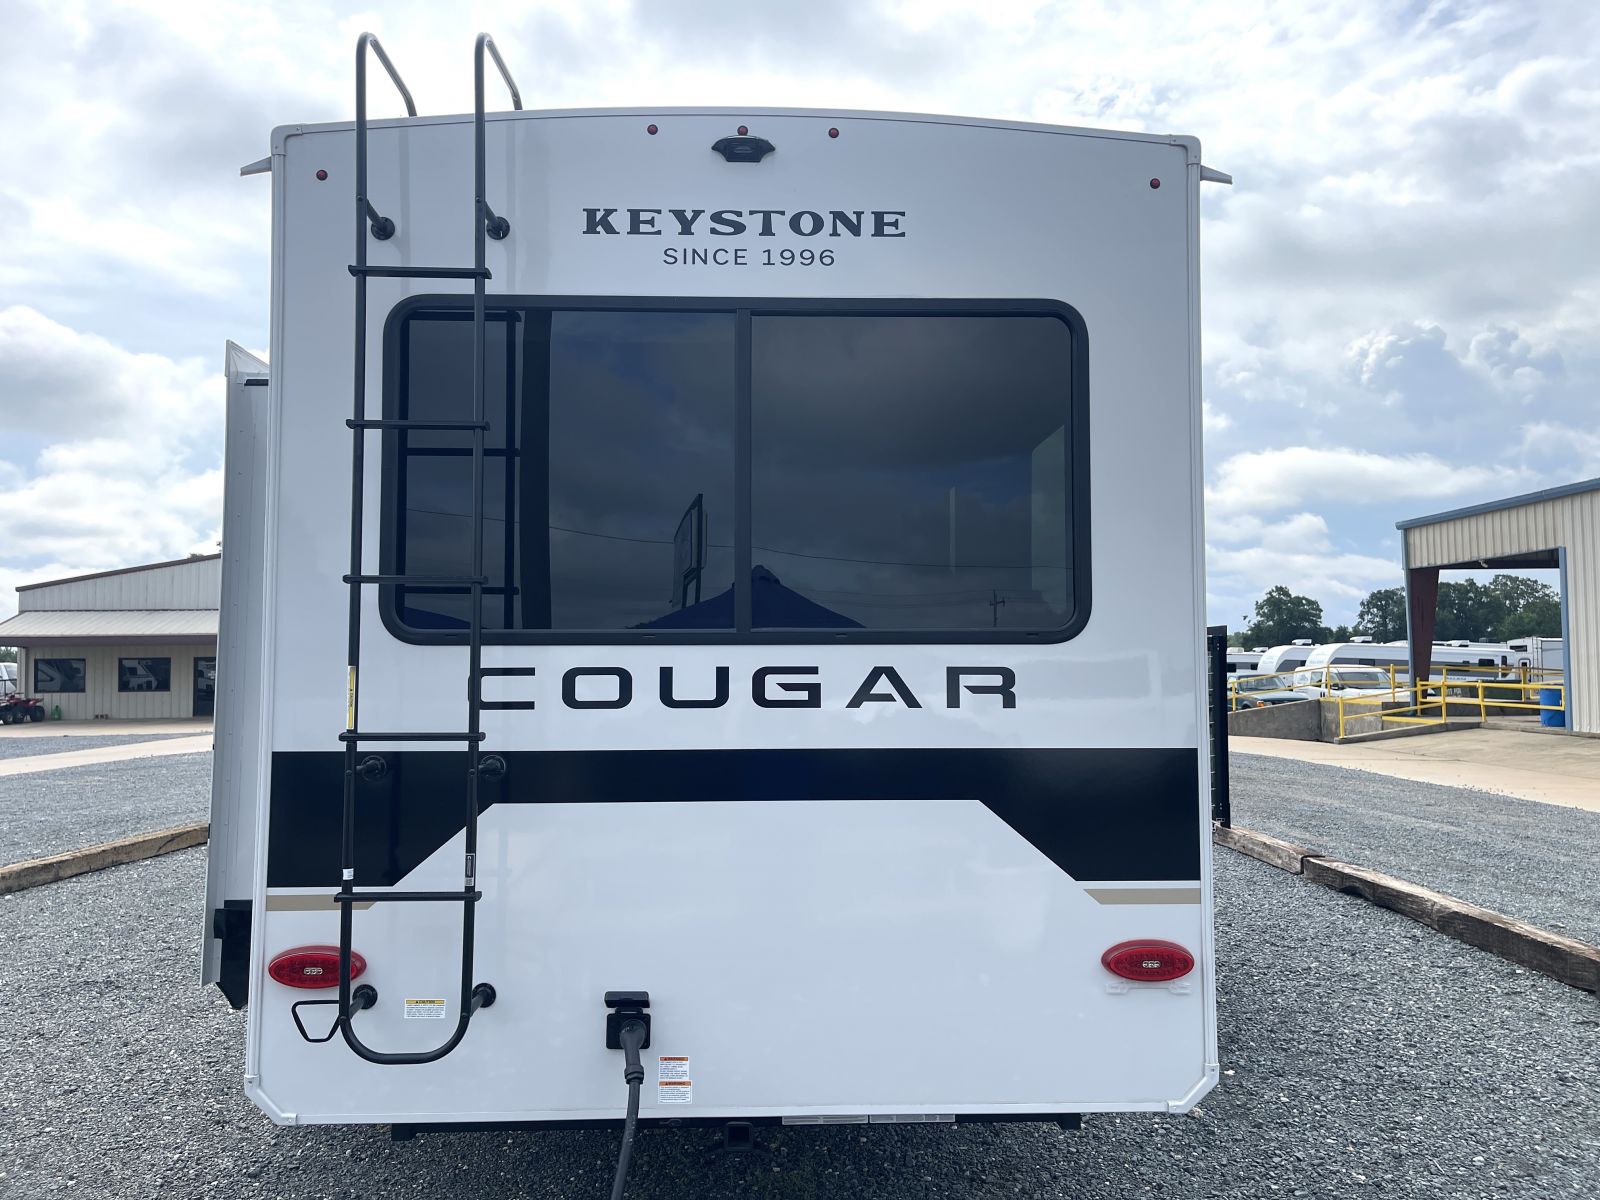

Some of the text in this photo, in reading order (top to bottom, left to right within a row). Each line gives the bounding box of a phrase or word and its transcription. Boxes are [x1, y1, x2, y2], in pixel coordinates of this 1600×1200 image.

[582, 207, 906, 238] KEYSTONE
[662, 247, 836, 267] SINCE 1996
[467, 665, 1017, 710] COUGAR
